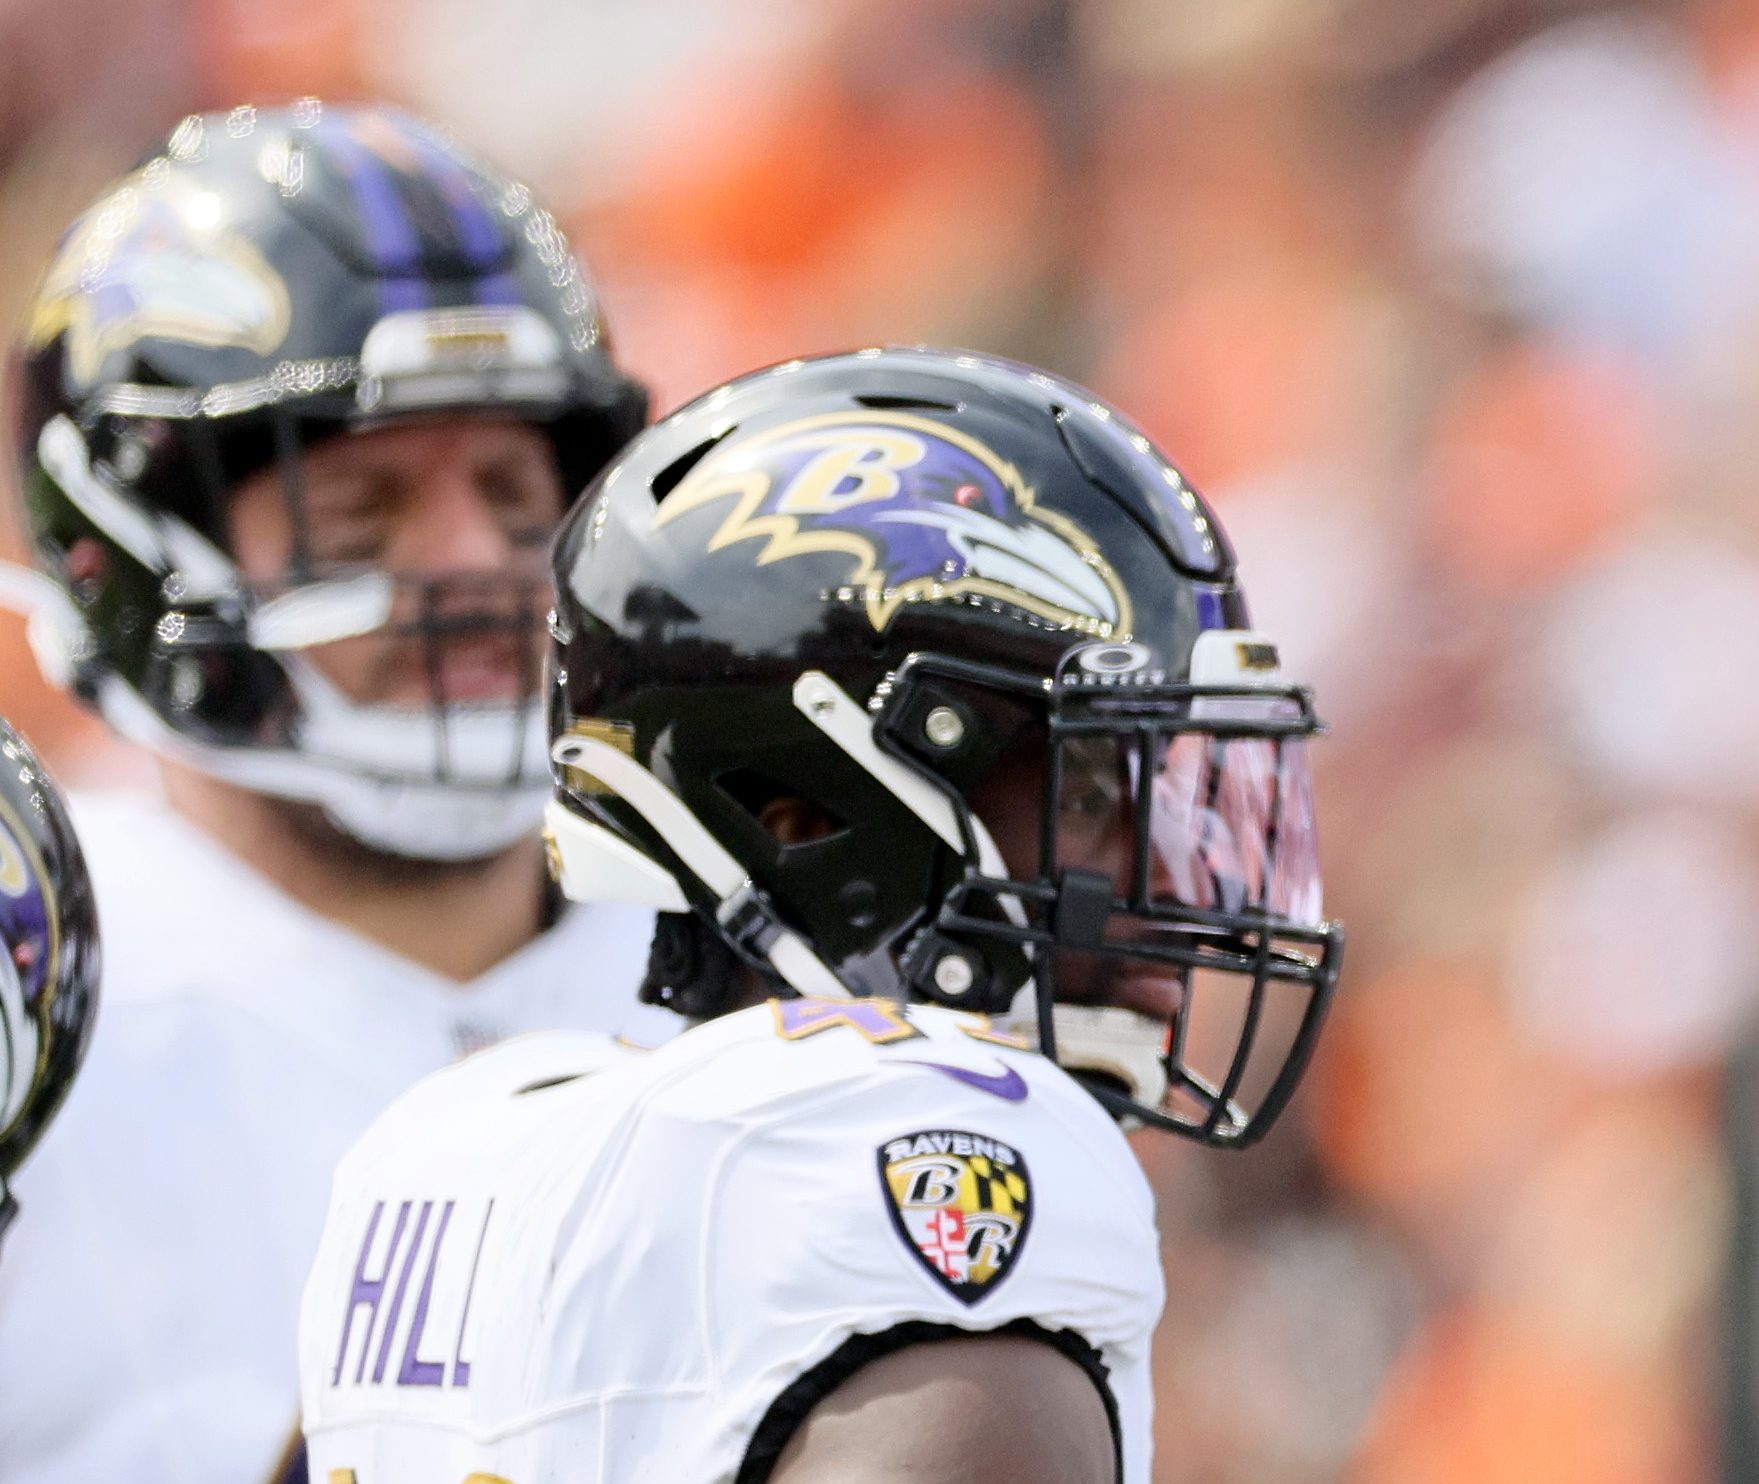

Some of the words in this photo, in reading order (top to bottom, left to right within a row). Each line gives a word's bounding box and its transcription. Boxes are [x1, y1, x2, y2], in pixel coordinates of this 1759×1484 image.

[885, 1132, 1016, 1167] RAVENS
[893, 1157, 965, 1206] B
[964, 1211, 1020, 1268] R
[331, 1196, 494, 1388] HILL
